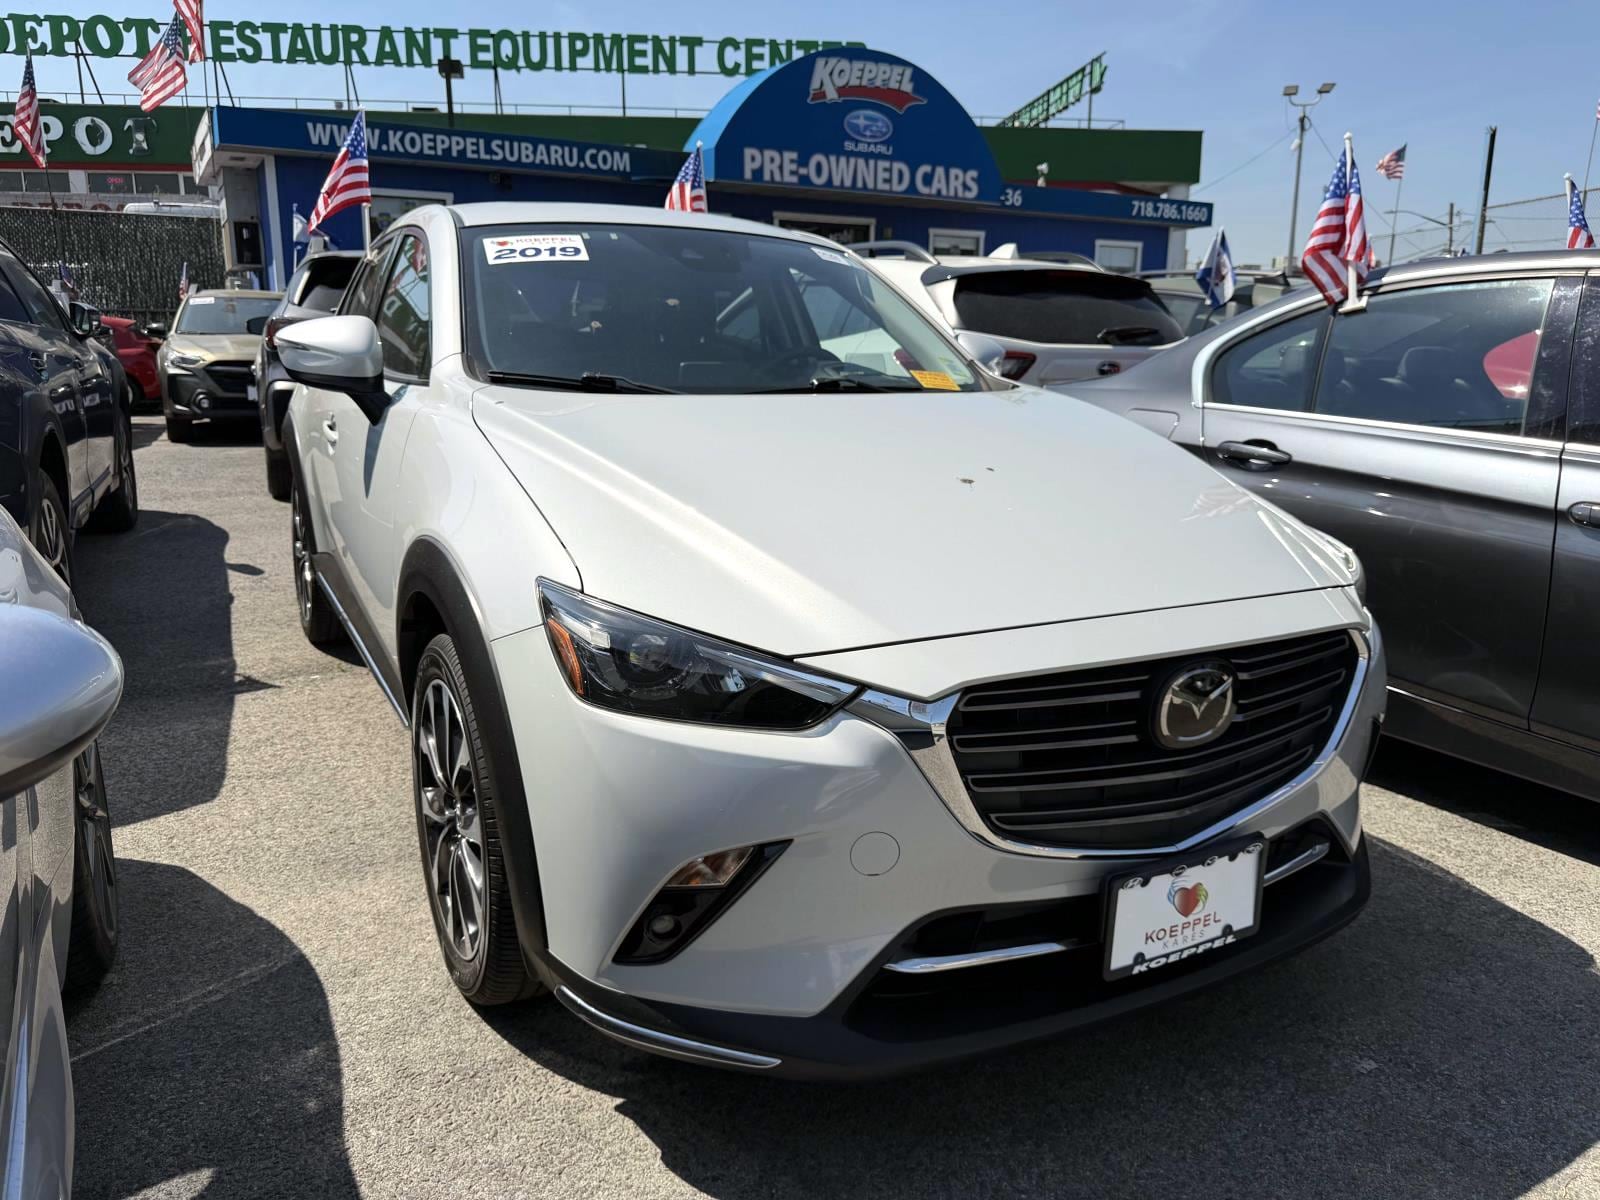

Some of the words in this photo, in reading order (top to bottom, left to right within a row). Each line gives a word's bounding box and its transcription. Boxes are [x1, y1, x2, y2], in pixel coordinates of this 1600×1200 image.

[0, 13, 160, 58] EPOT
[469, 29, 703, 76] EQUIPMENT
[811, 57, 915, 101] KOEPPEL
[843, 141, 893, 155] SUBARU
[743, 147, 911, 193] PRE-OWNED
[915, 164, 980, 199] CARS
[1131, 200, 1208, 222] 718.786.1660
[493, 246, 582, 261] 2019
[1144, 911, 1222, 945] KOEPPEL
[1132, 934, 1236, 975] KOEPPEL
